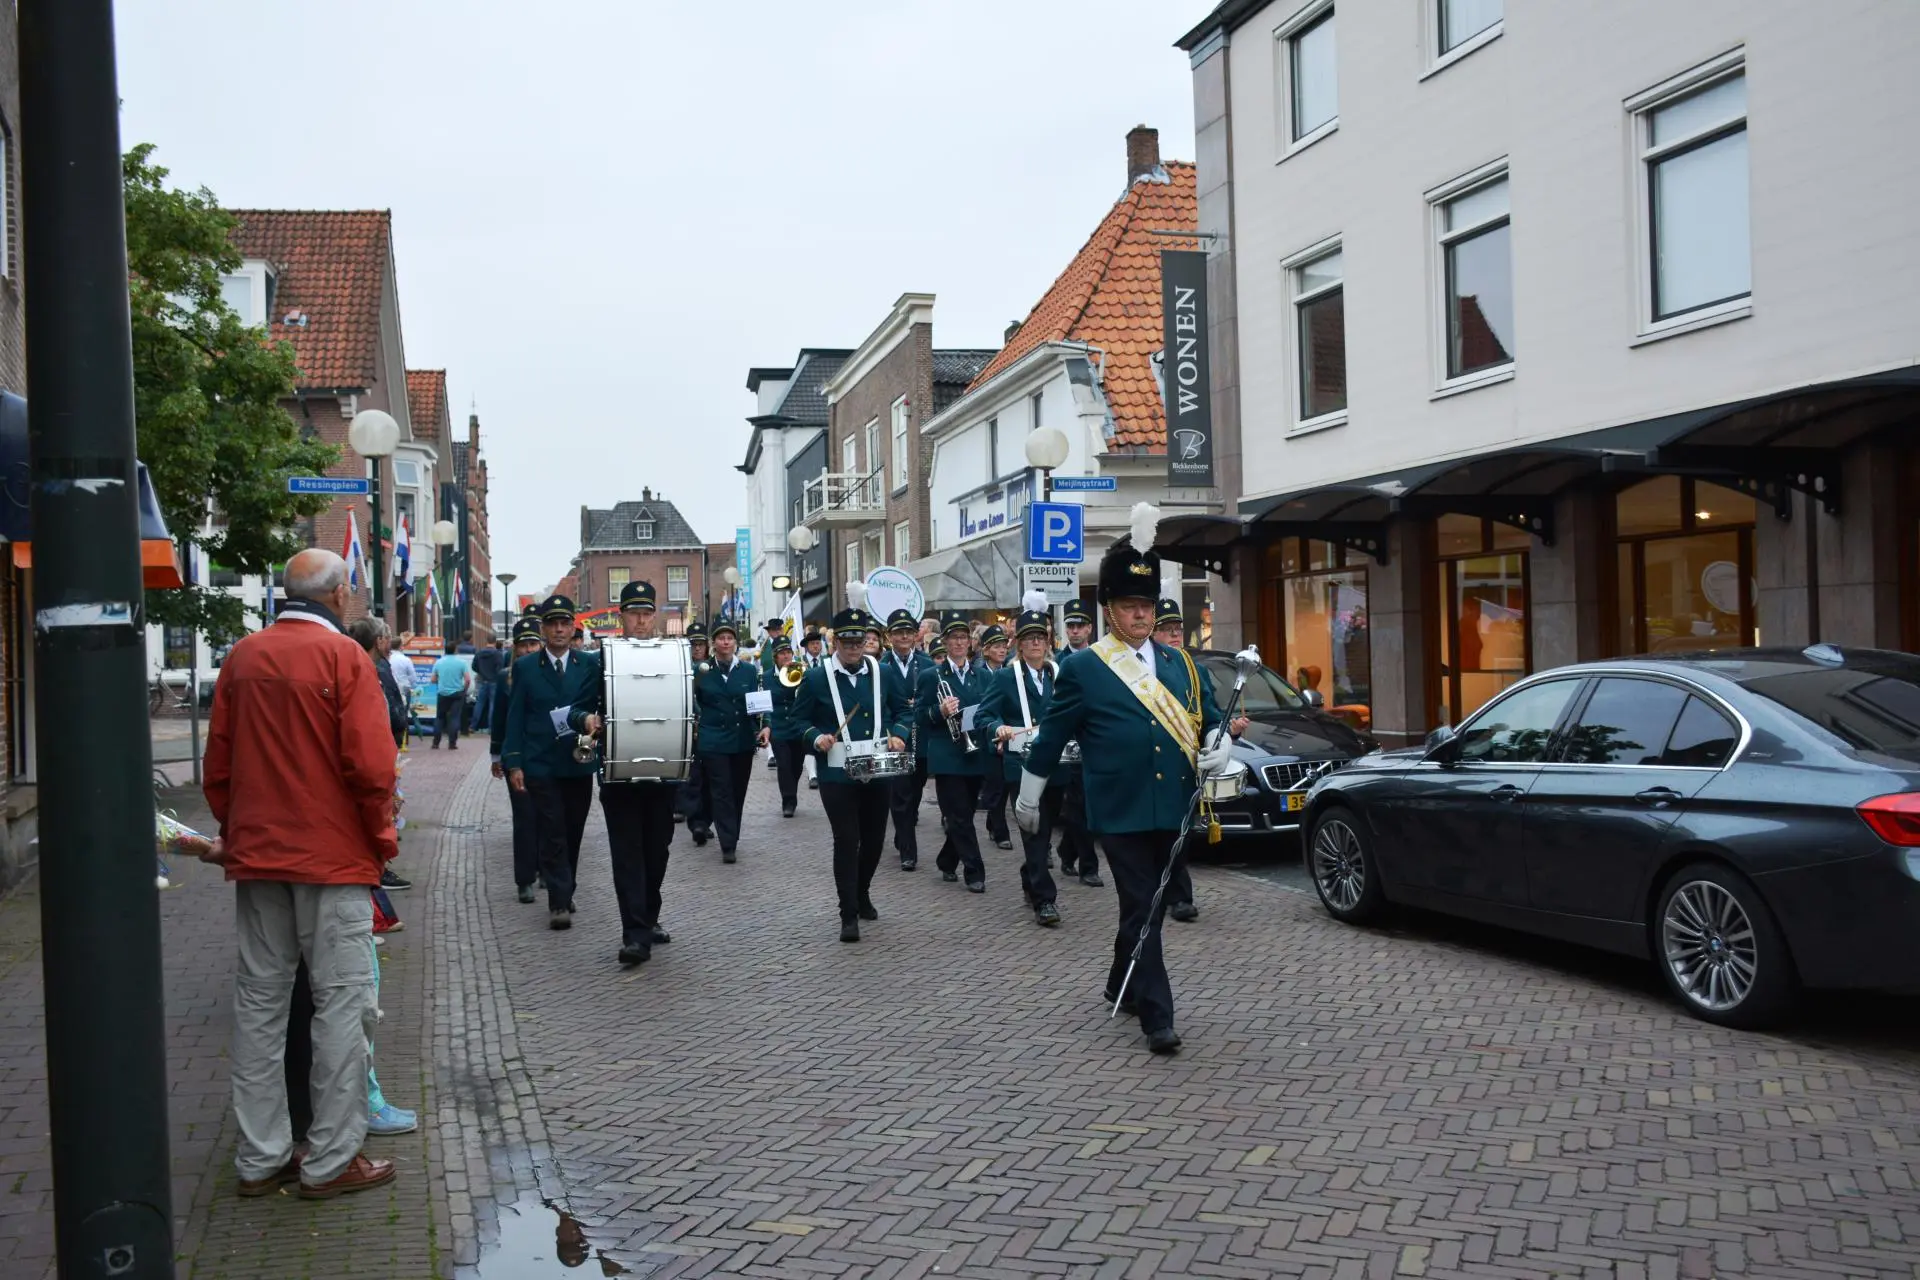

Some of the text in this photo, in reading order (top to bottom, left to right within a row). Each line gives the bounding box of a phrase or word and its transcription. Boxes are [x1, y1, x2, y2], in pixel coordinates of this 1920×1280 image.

[1175, 286, 1199, 416] WONEN
[1043, 510, 1071, 553] P
[872, 578, 912, 592] AMICITIA
[1028, 566, 1076, 576] EXPEDITIE
